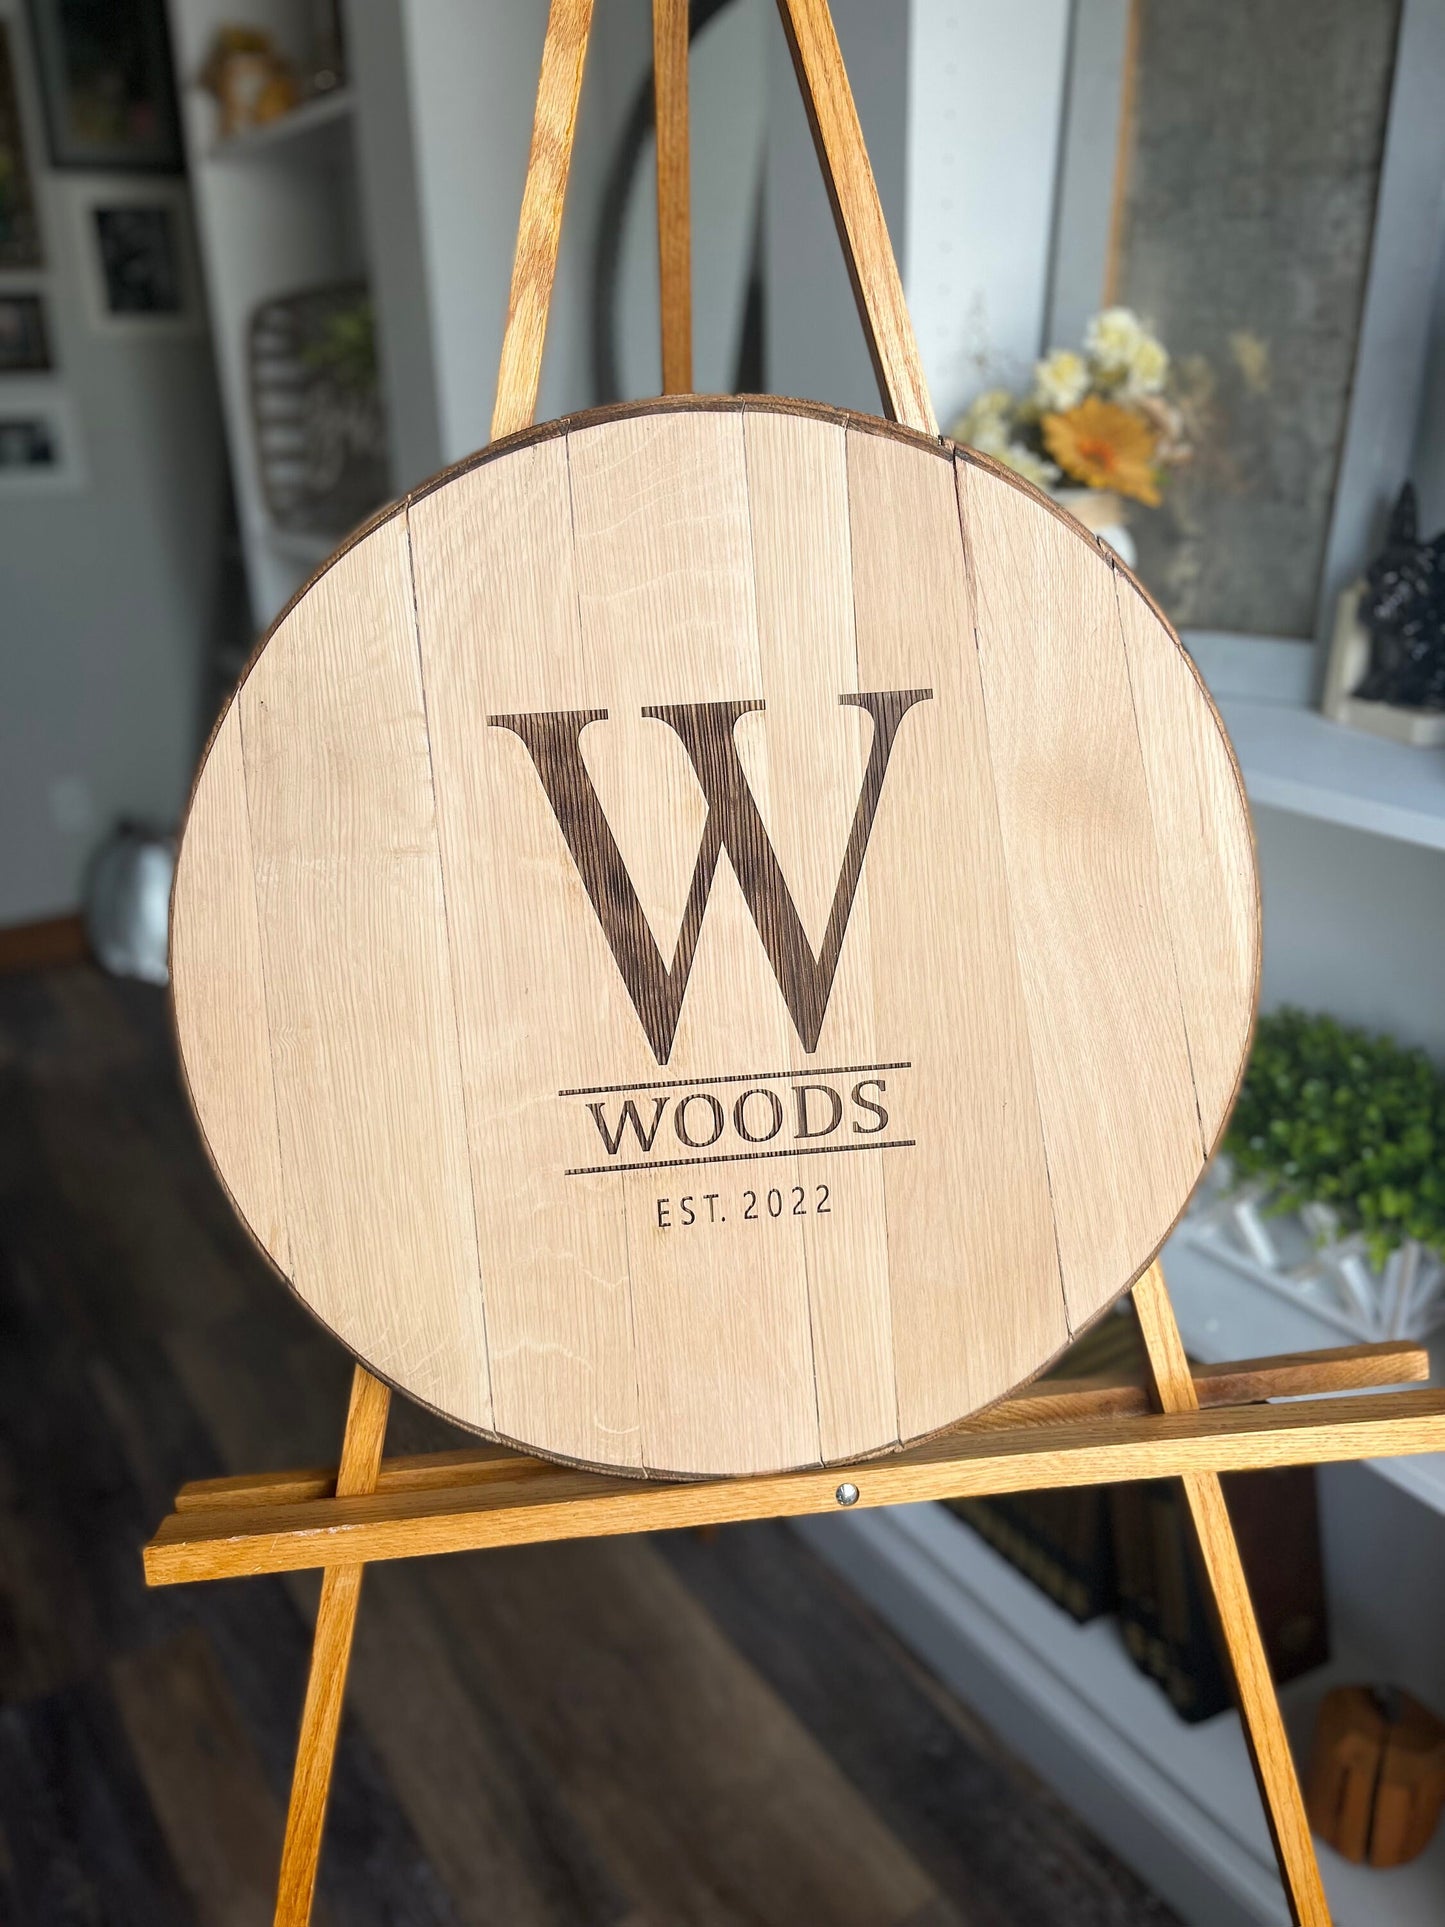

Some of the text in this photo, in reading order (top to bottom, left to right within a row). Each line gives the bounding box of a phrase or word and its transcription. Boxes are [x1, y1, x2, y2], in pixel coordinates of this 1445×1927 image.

[487, 689, 933, 1066] W
[585, 1079, 889, 1155] WOODS
[657, 1184, 832, 1228] EST. 2022
